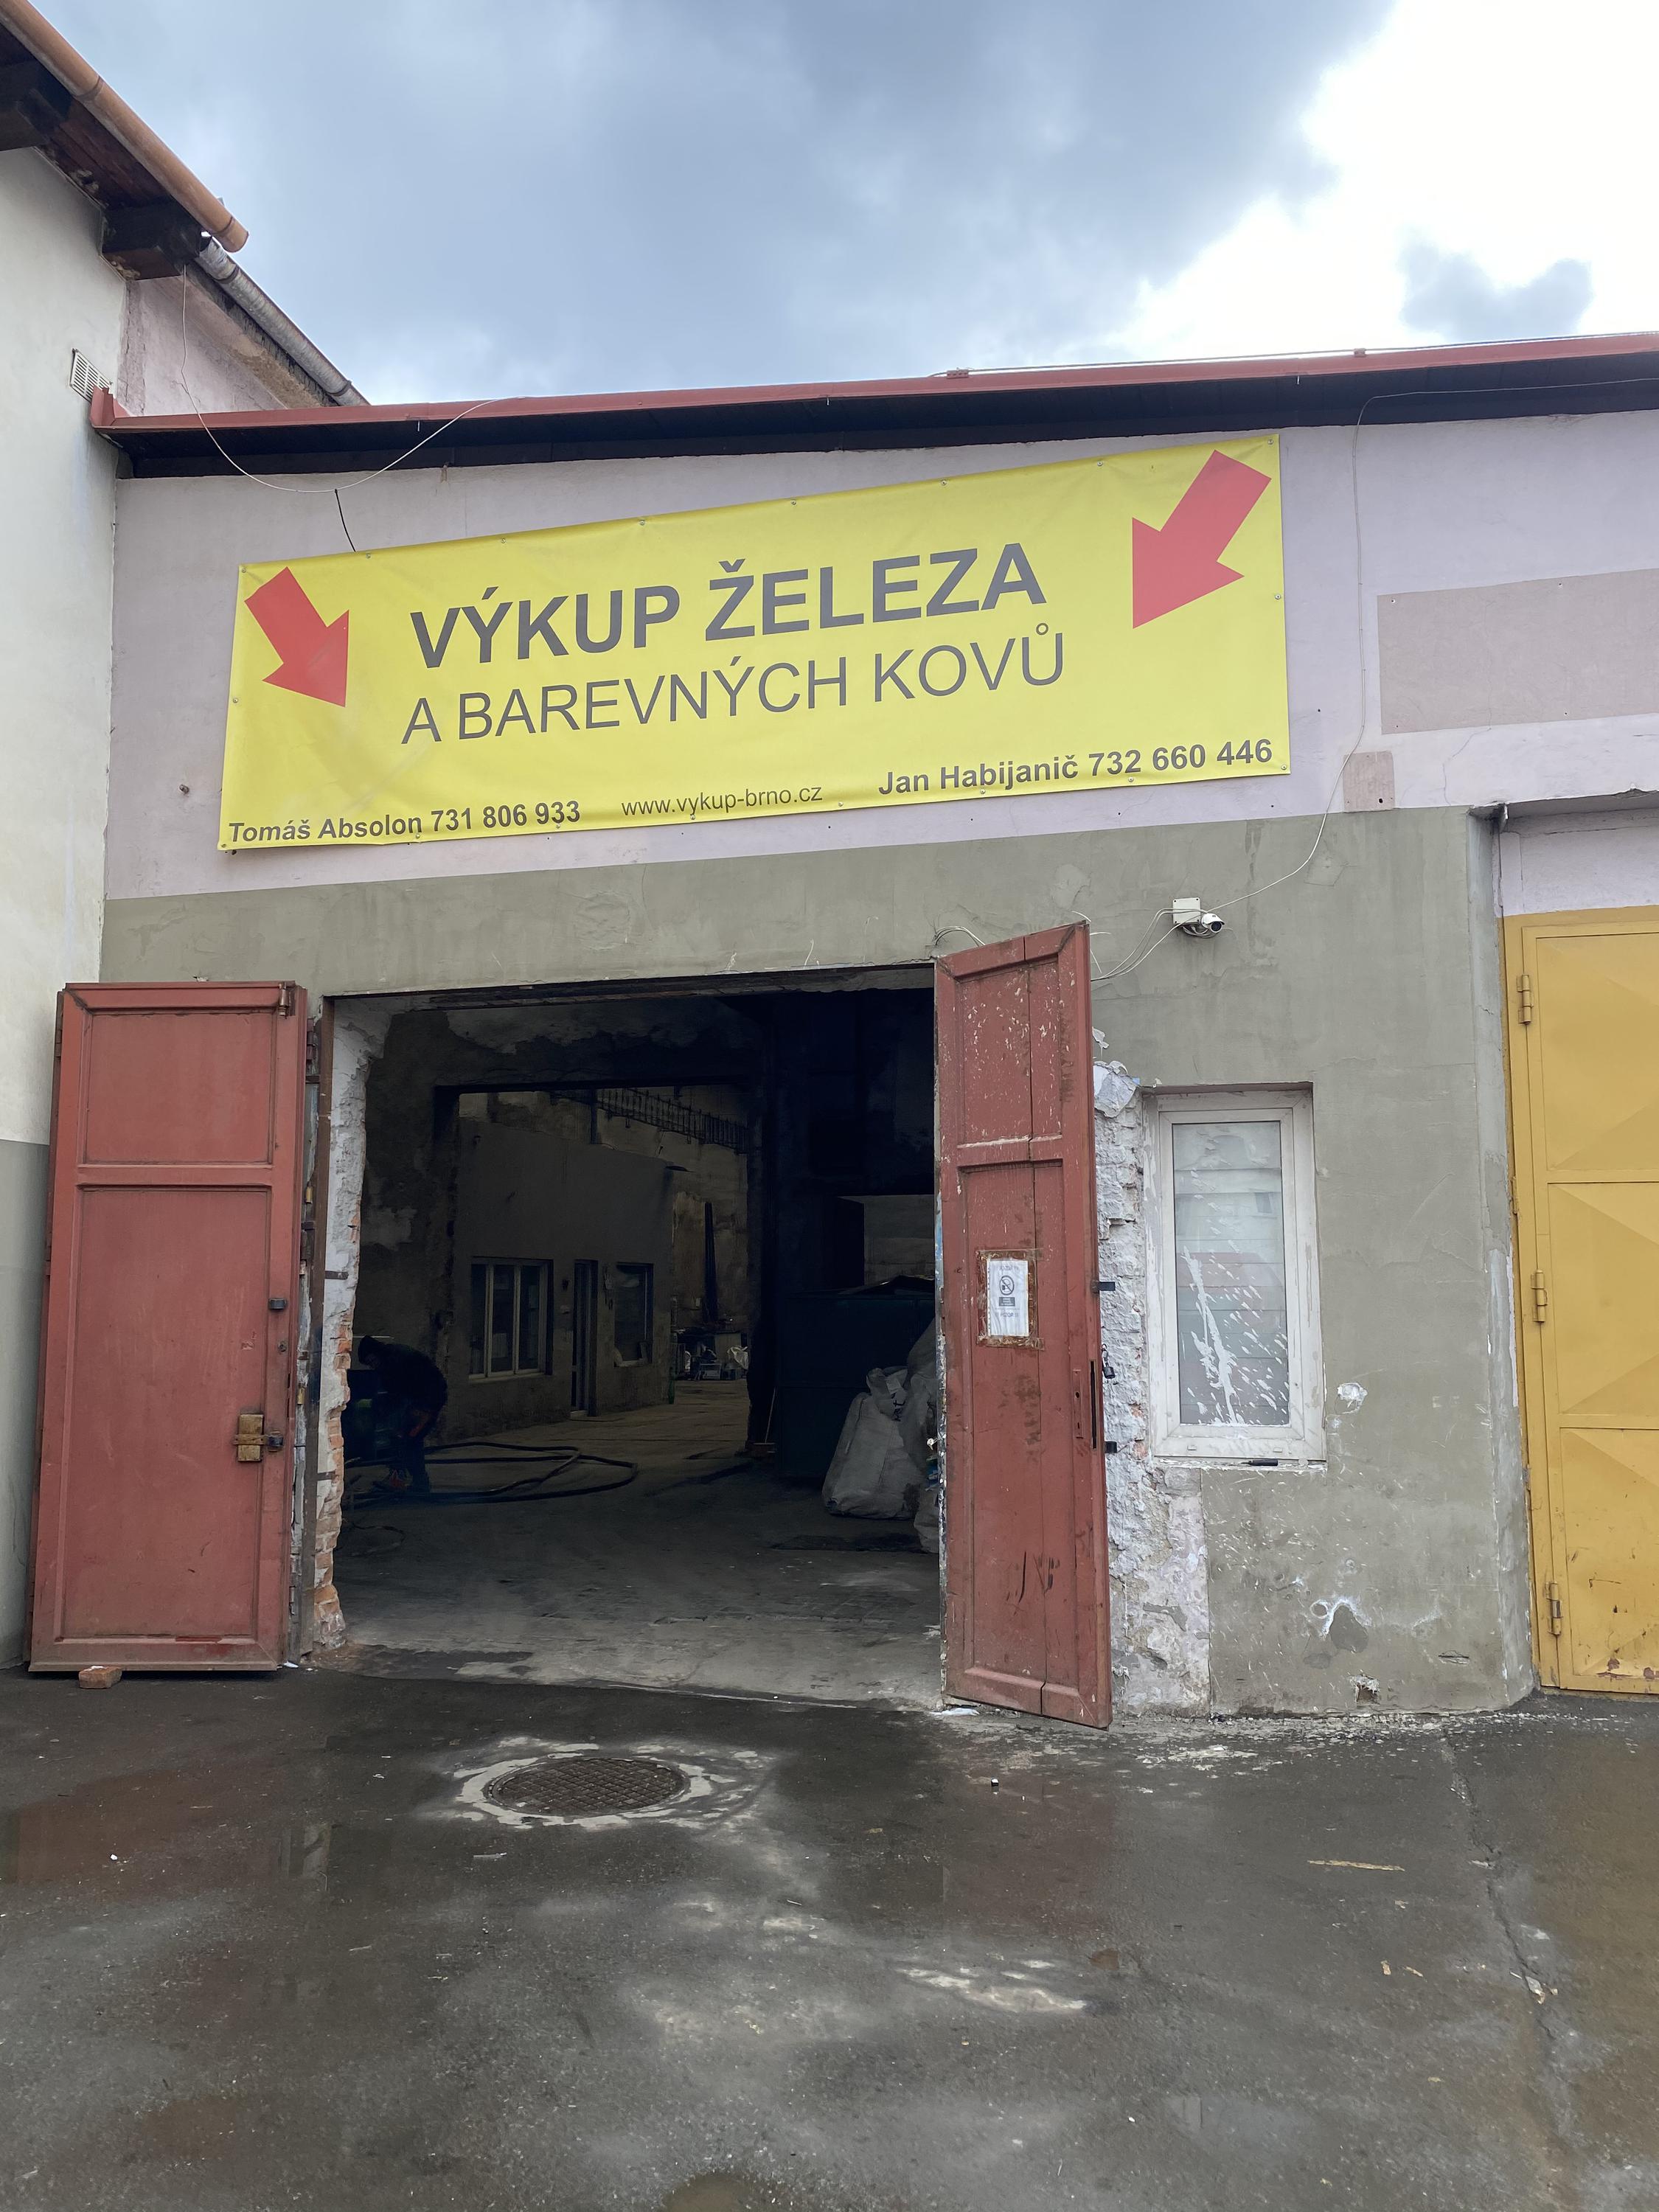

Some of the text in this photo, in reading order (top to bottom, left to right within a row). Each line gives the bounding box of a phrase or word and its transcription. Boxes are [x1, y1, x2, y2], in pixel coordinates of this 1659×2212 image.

[410, 542, 1047, 669] VÝKUP ŽELEZA
[401, 622, 1063, 745] A BAREVNÝCH KOVŮ
[878, 738, 1273, 795] Jan Habijanič 732 660 446
[229, 800, 580, 842] Tomáš Absolon 731 806 933
[621, 787, 823, 815] www.vykup-brno.cz
